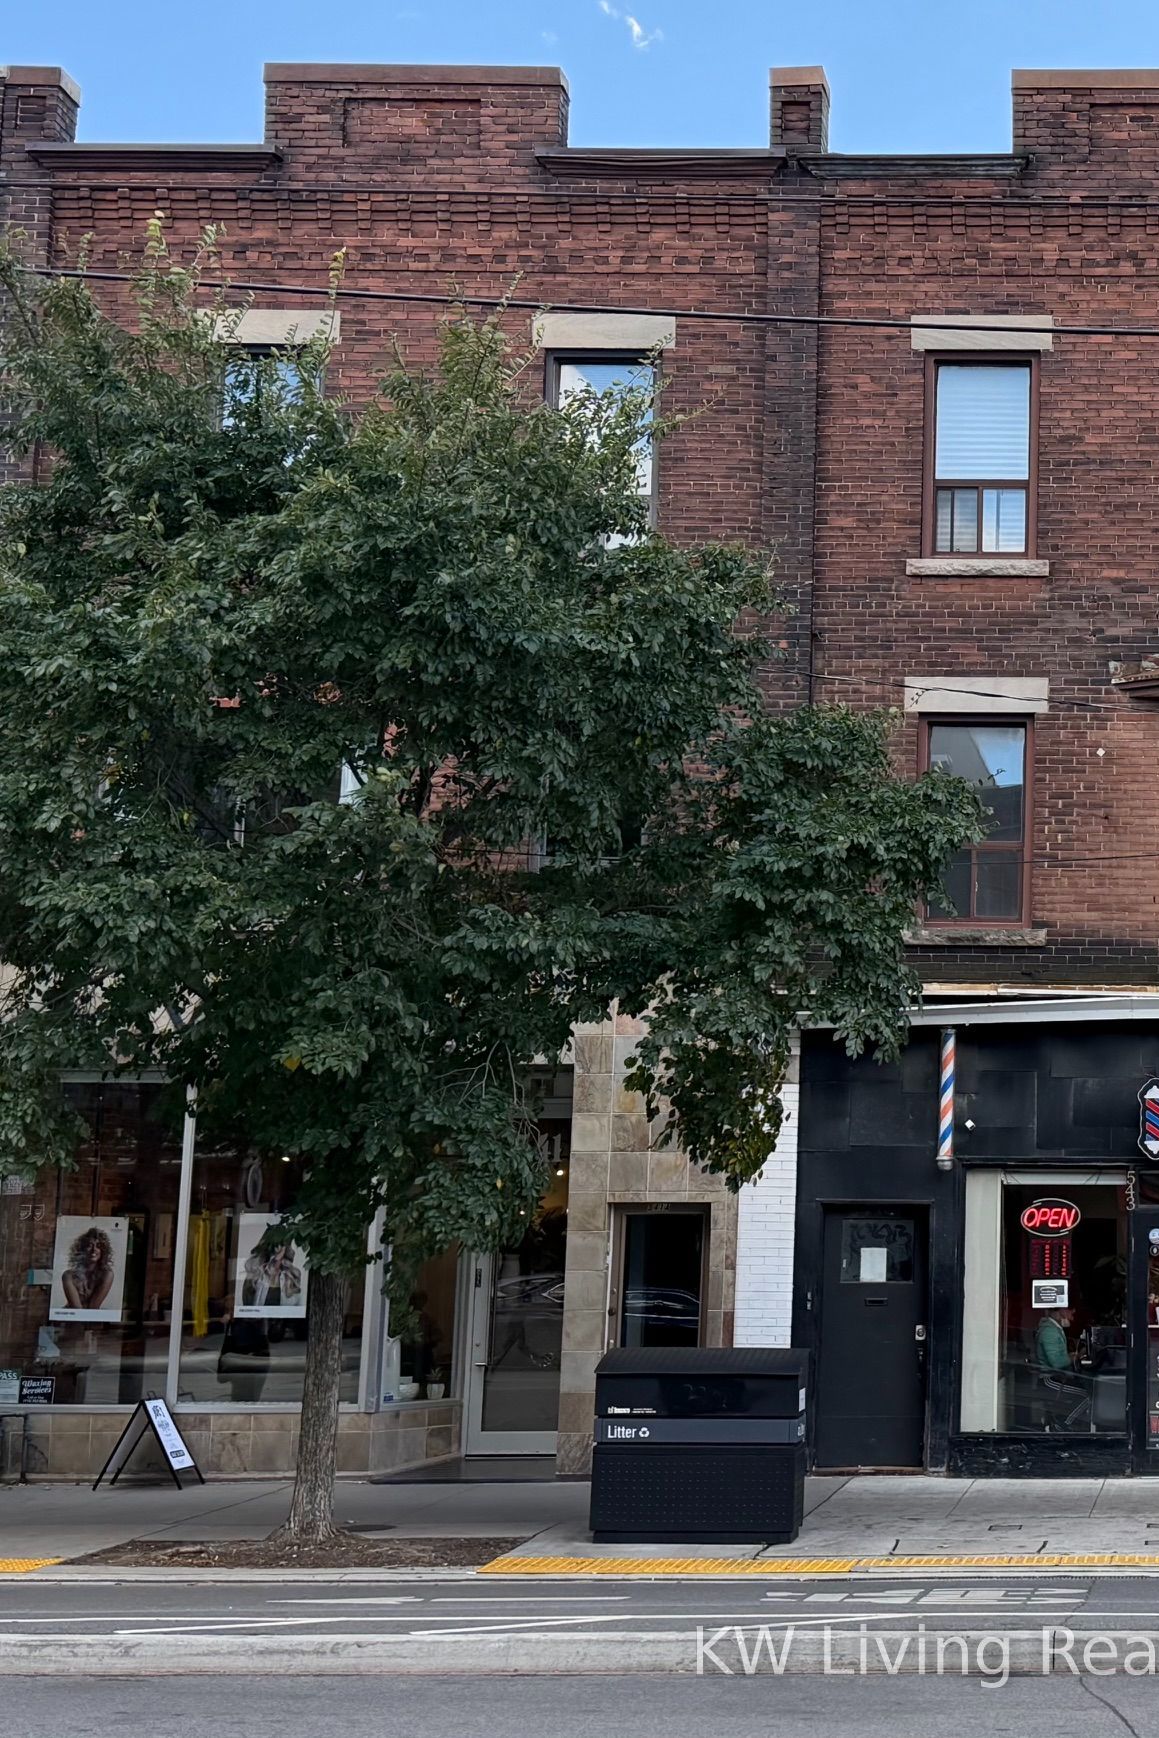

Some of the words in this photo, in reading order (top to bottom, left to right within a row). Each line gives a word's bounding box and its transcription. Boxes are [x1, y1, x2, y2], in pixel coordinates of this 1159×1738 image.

[1125, 1170, 1136, 1211] 543
[1023, 1207, 1077, 1229] OPEN
[22, 1379, 52, 1389] Waxing
[22, 1387, 52, 1395] Services
[607, 1425, 638, 1439] Litter
